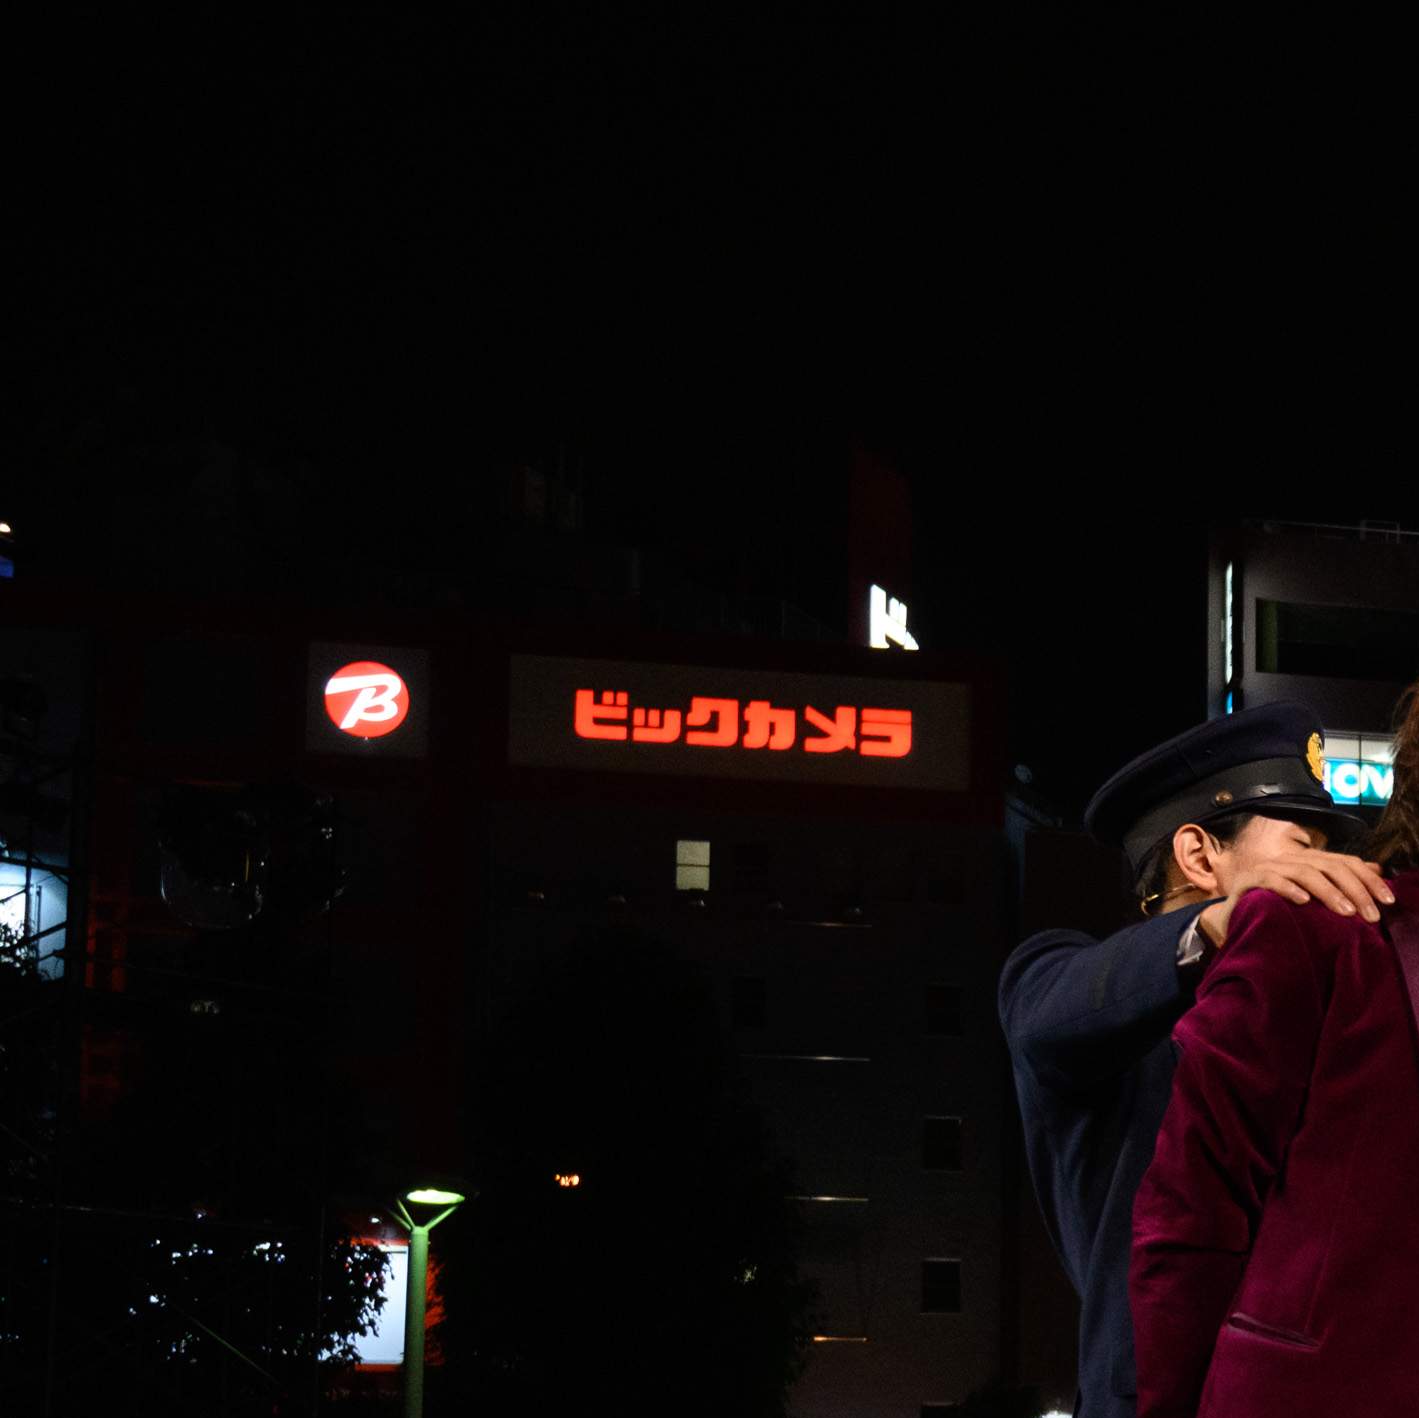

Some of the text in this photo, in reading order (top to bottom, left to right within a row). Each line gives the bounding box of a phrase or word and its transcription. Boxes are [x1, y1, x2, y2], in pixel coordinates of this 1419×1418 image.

[574, 688, 913, 758] ビックカメラ
[1322, 762, 1395, 799] OV
